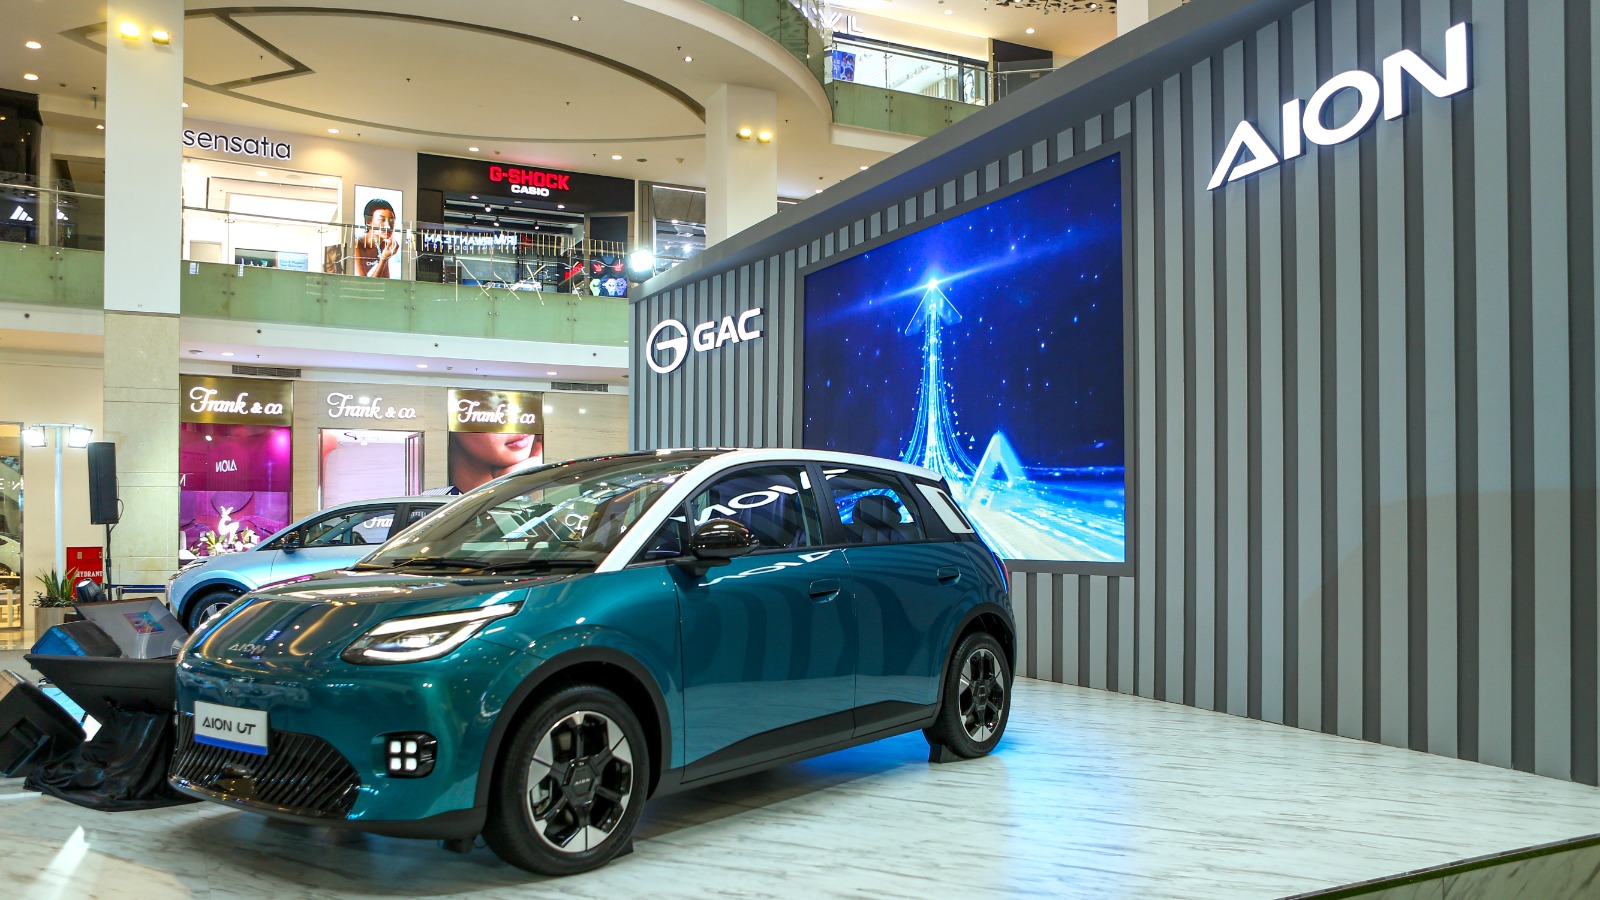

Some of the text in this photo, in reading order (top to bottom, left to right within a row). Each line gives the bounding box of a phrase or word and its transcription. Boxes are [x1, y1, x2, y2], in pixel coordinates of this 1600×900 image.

[1207, 22, 1472, 191] AION
[182, 129, 292, 160] sensatia
[489, 165, 571, 191] G-SHOCK
[511, 184, 550, 197] CASIO
[692, 307, 764, 352] GAC
[189, 386, 248, 415] Frank
[250, 402, 262, 413] &
[326, 392, 383, 420] Frank
[384, 406, 396, 418] &
[457, 399, 506, 424] Frank
[228, 643, 266, 654] AION
[202, 716, 256, 735] AION UT
